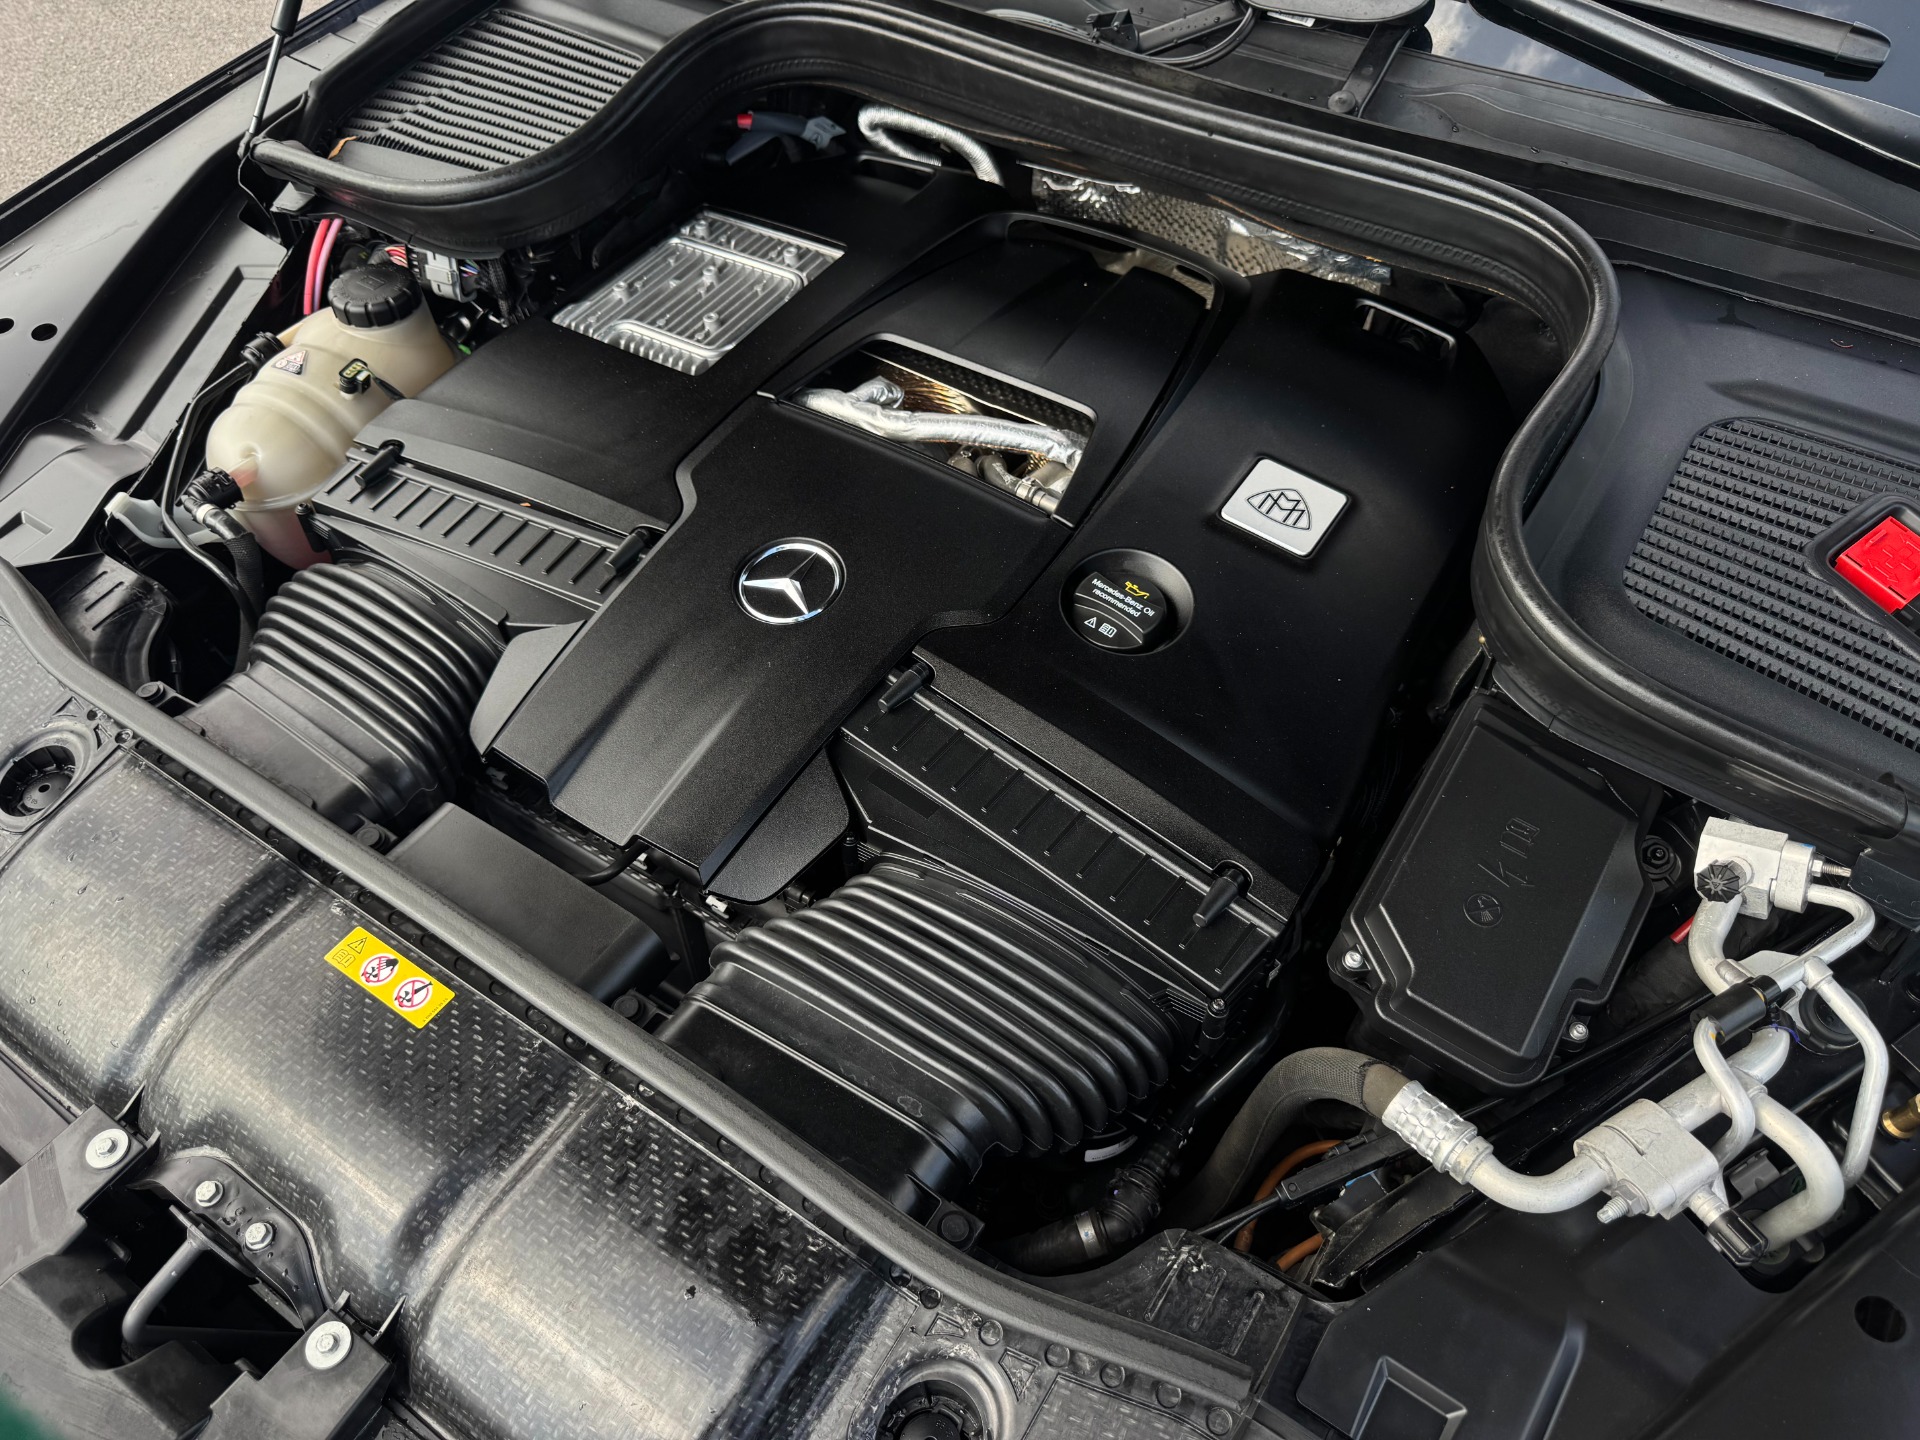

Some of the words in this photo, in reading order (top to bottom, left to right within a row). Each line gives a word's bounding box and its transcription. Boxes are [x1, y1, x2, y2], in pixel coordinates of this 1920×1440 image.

[1092, 578, 1143, 611] Mercedes-Benz
[1143, 606, 1155, 617] Oil
[1092, 587, 1142, 618] recommended
